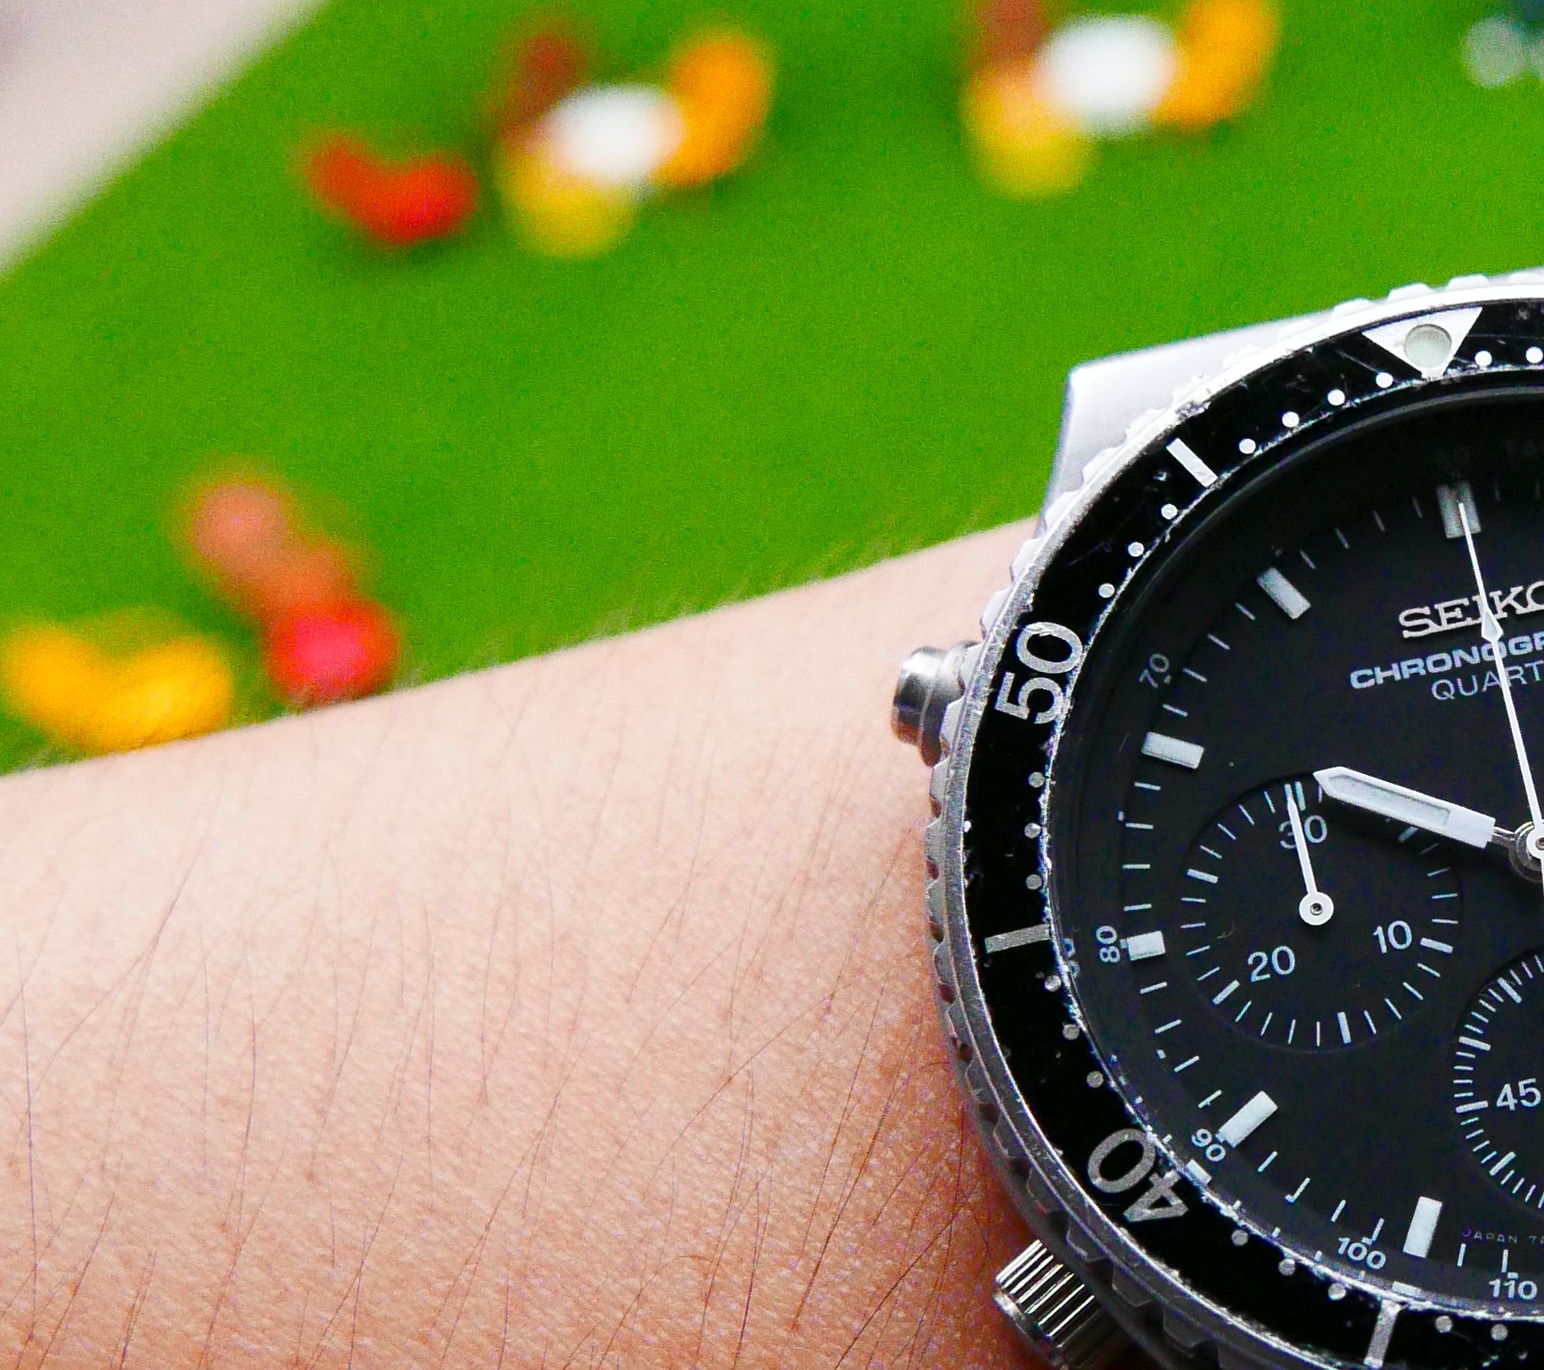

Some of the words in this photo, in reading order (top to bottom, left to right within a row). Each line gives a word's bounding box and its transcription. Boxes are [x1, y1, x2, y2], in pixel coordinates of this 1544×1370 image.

[995, 621, 1083, 724] 50
[1279, 814, 1328, 849] 30
[1096, 925, 1120, 963] 80
[1372, 920, 1412, 954] 10
[1247, 945, 1295, 982] 20
[1496, 1078, 1541, 1111] 45
[1191, 1128, 1226, 1162] 90
[1087, 1128, 1189, 1222] 40
[1338, 1237, 1386, 1269] 100
[1462, 1229, 1518, 1244] JAPAN
[1489, 1278, 1537, 1300] 110
